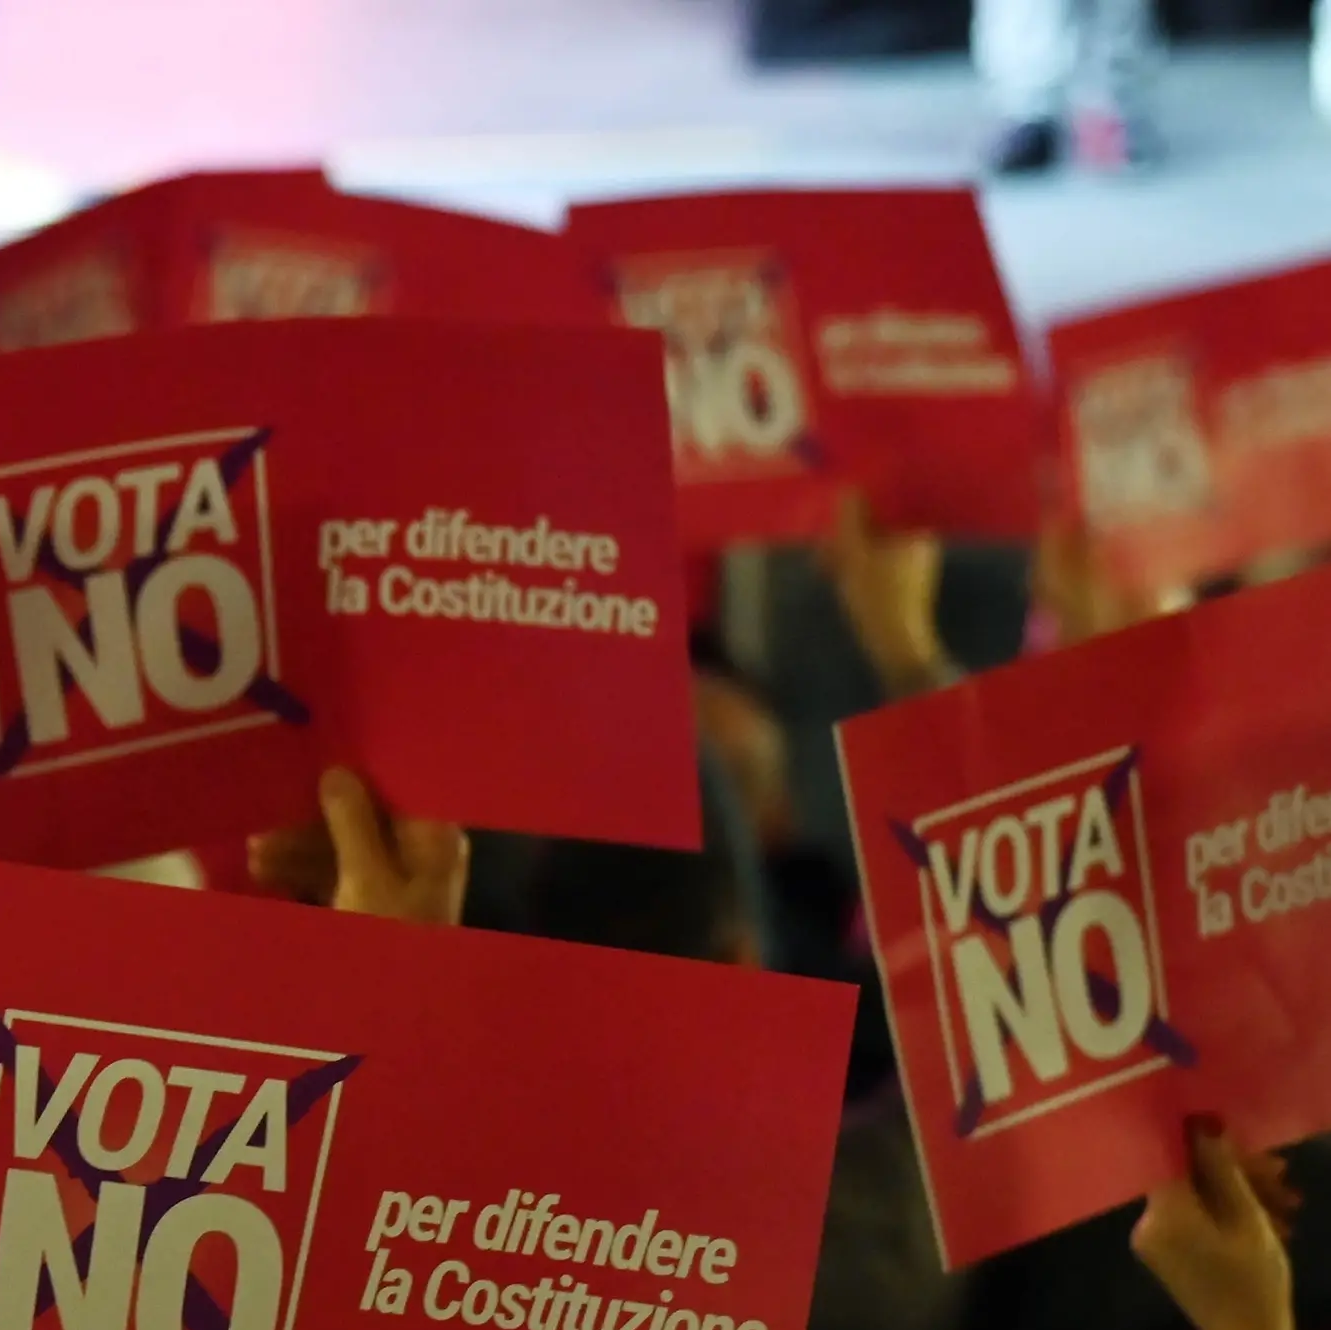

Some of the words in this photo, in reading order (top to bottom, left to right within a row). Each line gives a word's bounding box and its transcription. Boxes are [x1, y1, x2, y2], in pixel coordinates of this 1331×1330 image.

[319, 518, 394, 569] per
[405, 507, 619, 574] difendere
[11, 555, 260, 743] NO
[326, 566, 368, 614] la
[378, 564, 658, 637] Costituzione
[928, 786, 1123, 934] VOTA
[1186, 820, 1248, 890] per
[1255, 785, 1331, 853] dife
[1198, 884, 1233, 936] la
[952, 892, 1152, 1103] NO
[14, 1045, 288, 1193] VOTA
[360, 1250, 412, 1315] la
[364, 1190, 471, 1251] per
[473, 1187, 738, 1285] difendere
